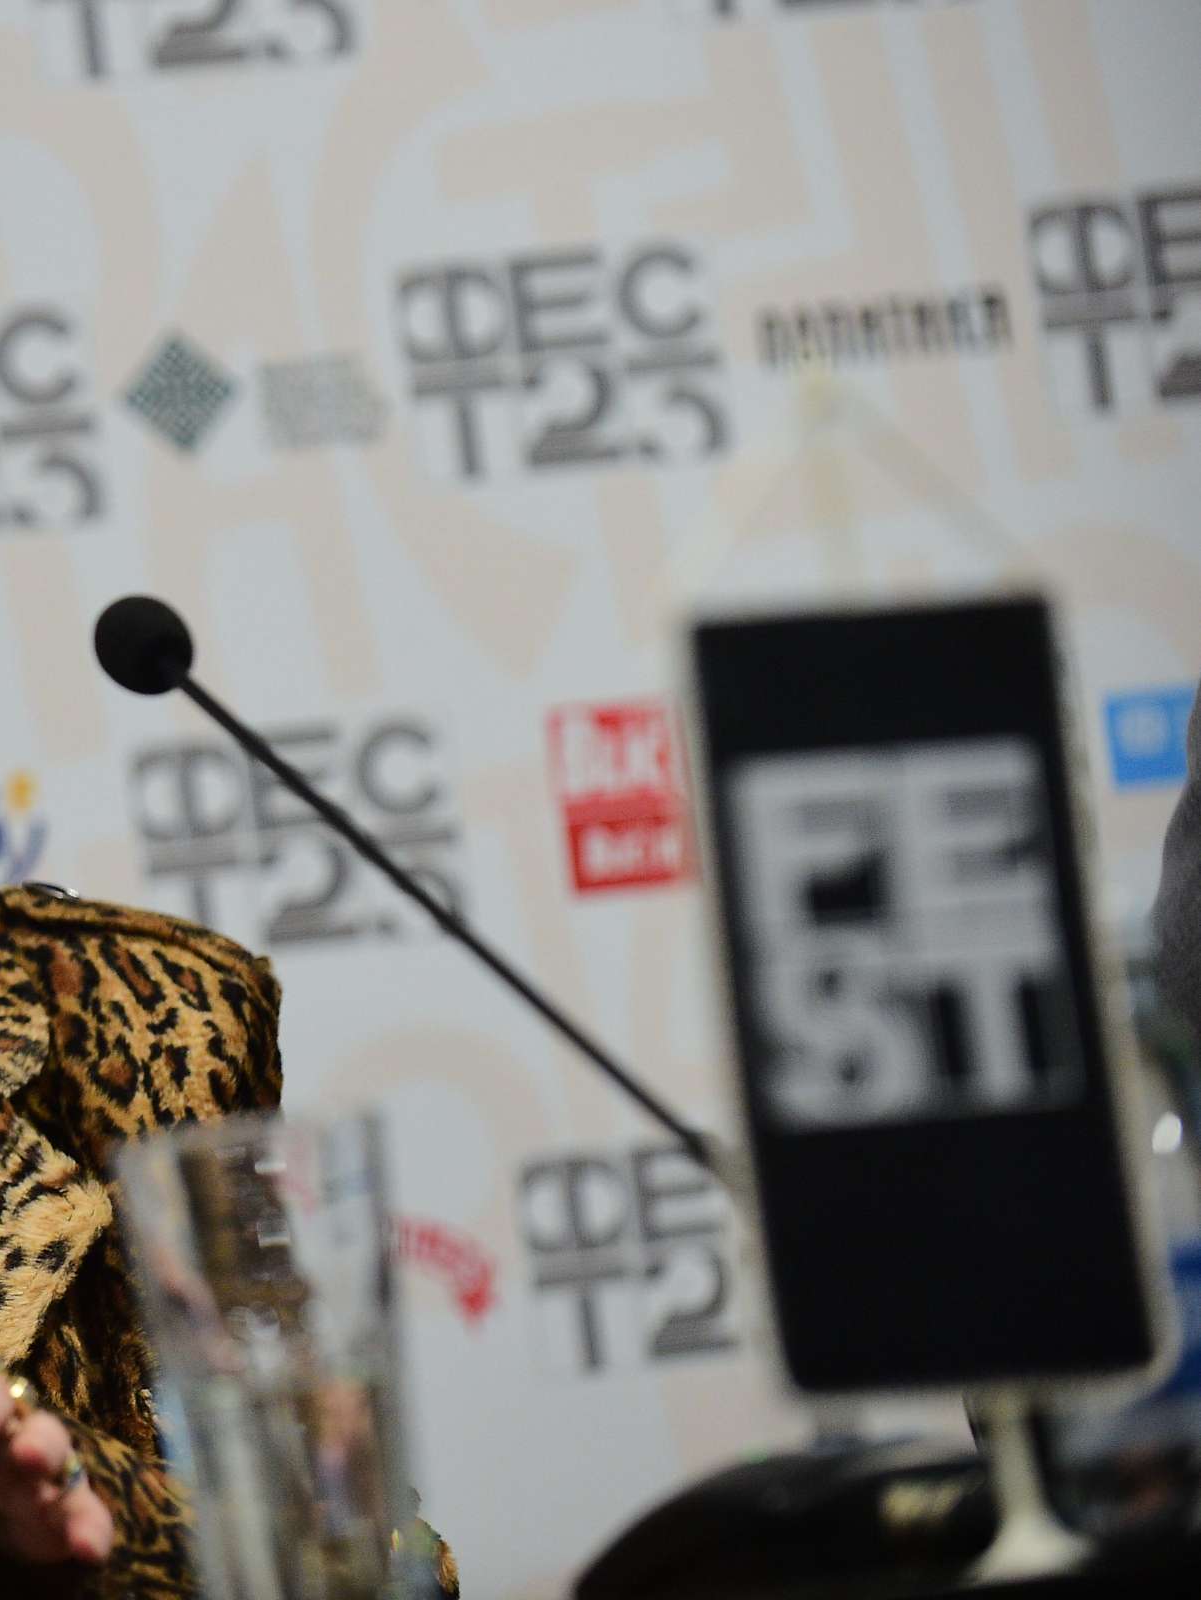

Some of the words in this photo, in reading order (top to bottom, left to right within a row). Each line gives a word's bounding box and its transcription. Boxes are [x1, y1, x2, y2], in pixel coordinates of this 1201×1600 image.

[395, 242, 707, 362] ФЕС
[517, 1146, 729, 1255] ФЕ
[532, 1246, 743, 1368] Т2
